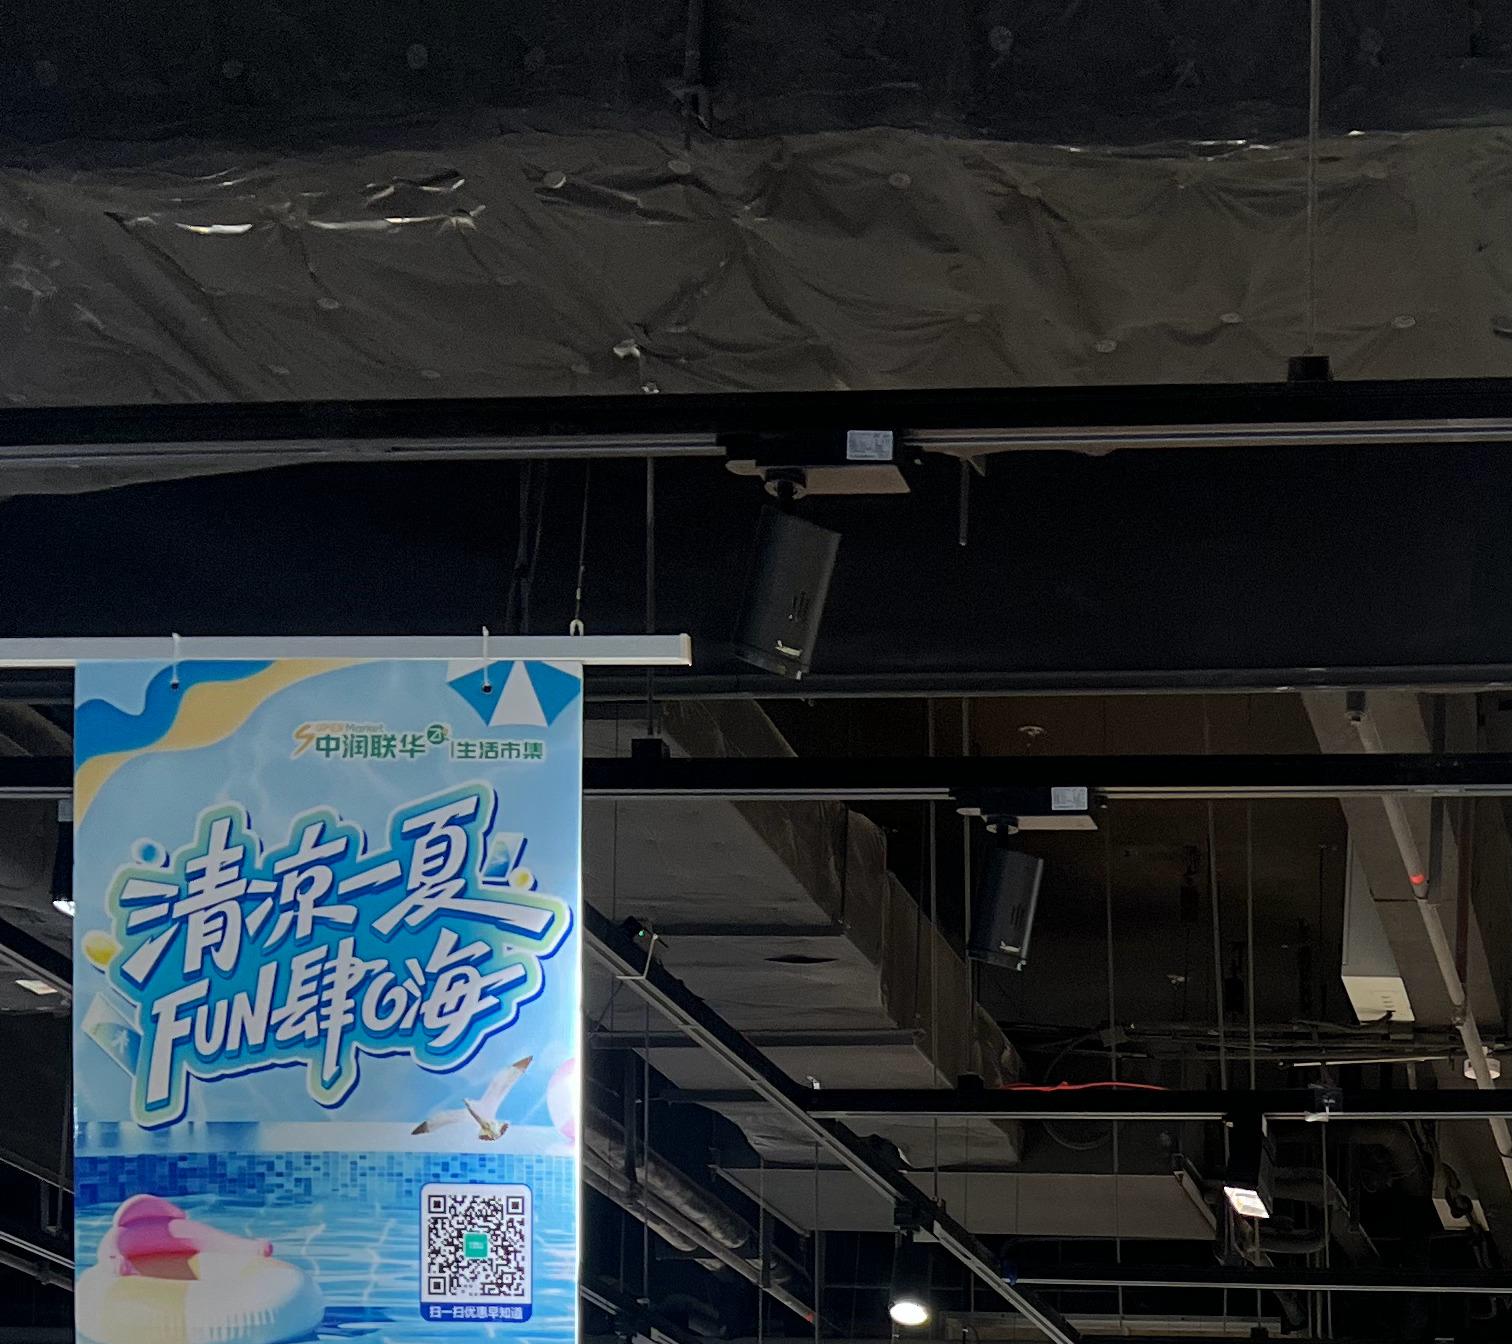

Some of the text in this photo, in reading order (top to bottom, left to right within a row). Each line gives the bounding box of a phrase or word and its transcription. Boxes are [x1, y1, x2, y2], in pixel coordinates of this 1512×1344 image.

[315, 734, 544, 760] 中润联华 生活市集
[119, 794, 556, 982] 清凉一夏
